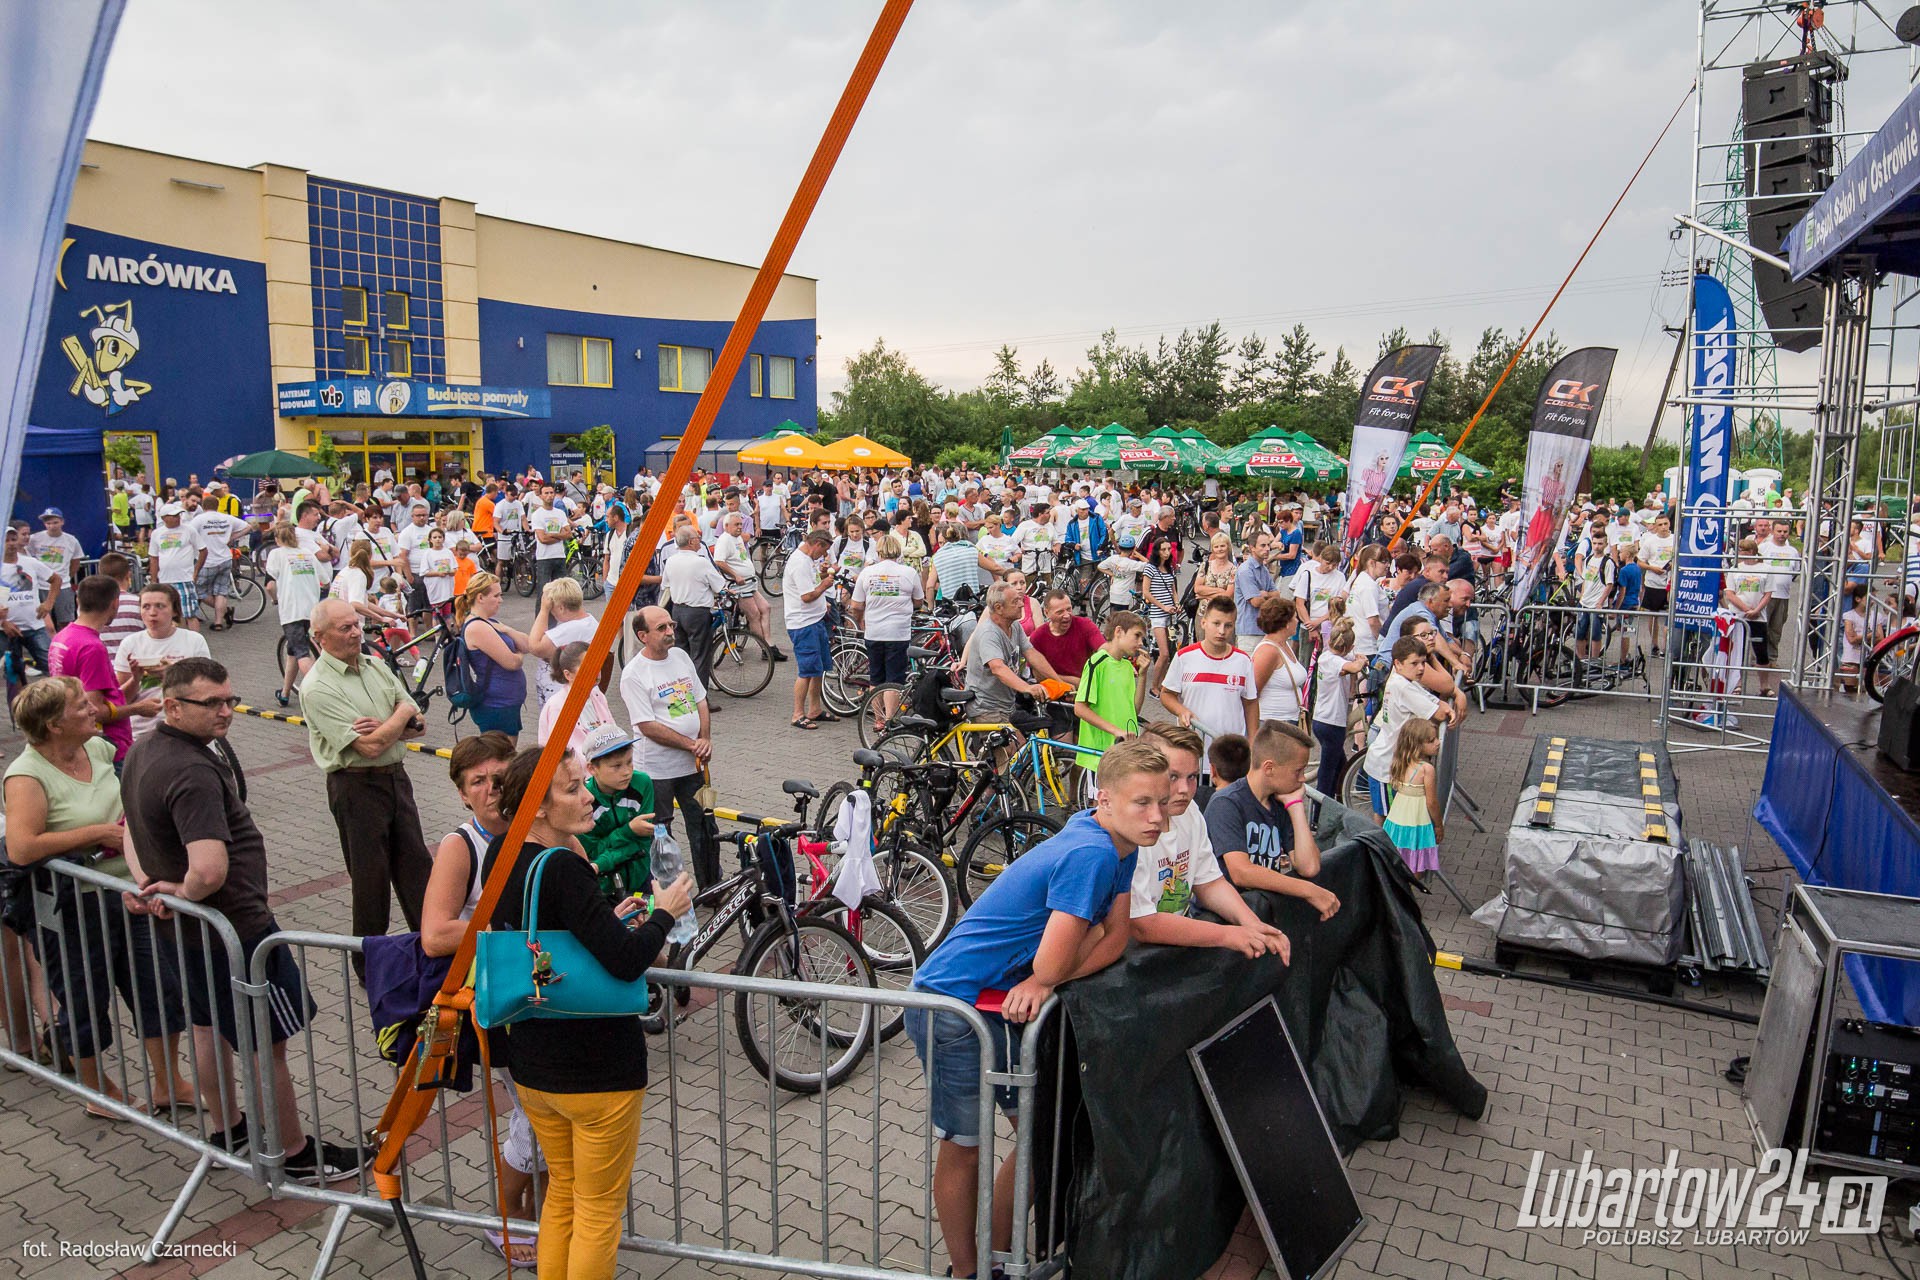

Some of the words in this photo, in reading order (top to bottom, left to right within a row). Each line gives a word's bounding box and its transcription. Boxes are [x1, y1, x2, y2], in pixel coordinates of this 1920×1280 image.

[1858, 174, 1868, 205] w
[1870, 122, 1918, 193] Ostrowie
[86, 253, 238, 295] MRÓWKA
[1368, 407, 1381, 416] Fit
[1381, 408, 1395, 417] for
[1392, 412, 1412, 421] you
[1544, 412, 1557, 421] Fit
[1557, 413, 1571, 423] for
[1569, 416, 1587, 426] you
[1121, 450, 1162, 459] PERŁA
[1251, 455, 1299, 463] PERŁA
